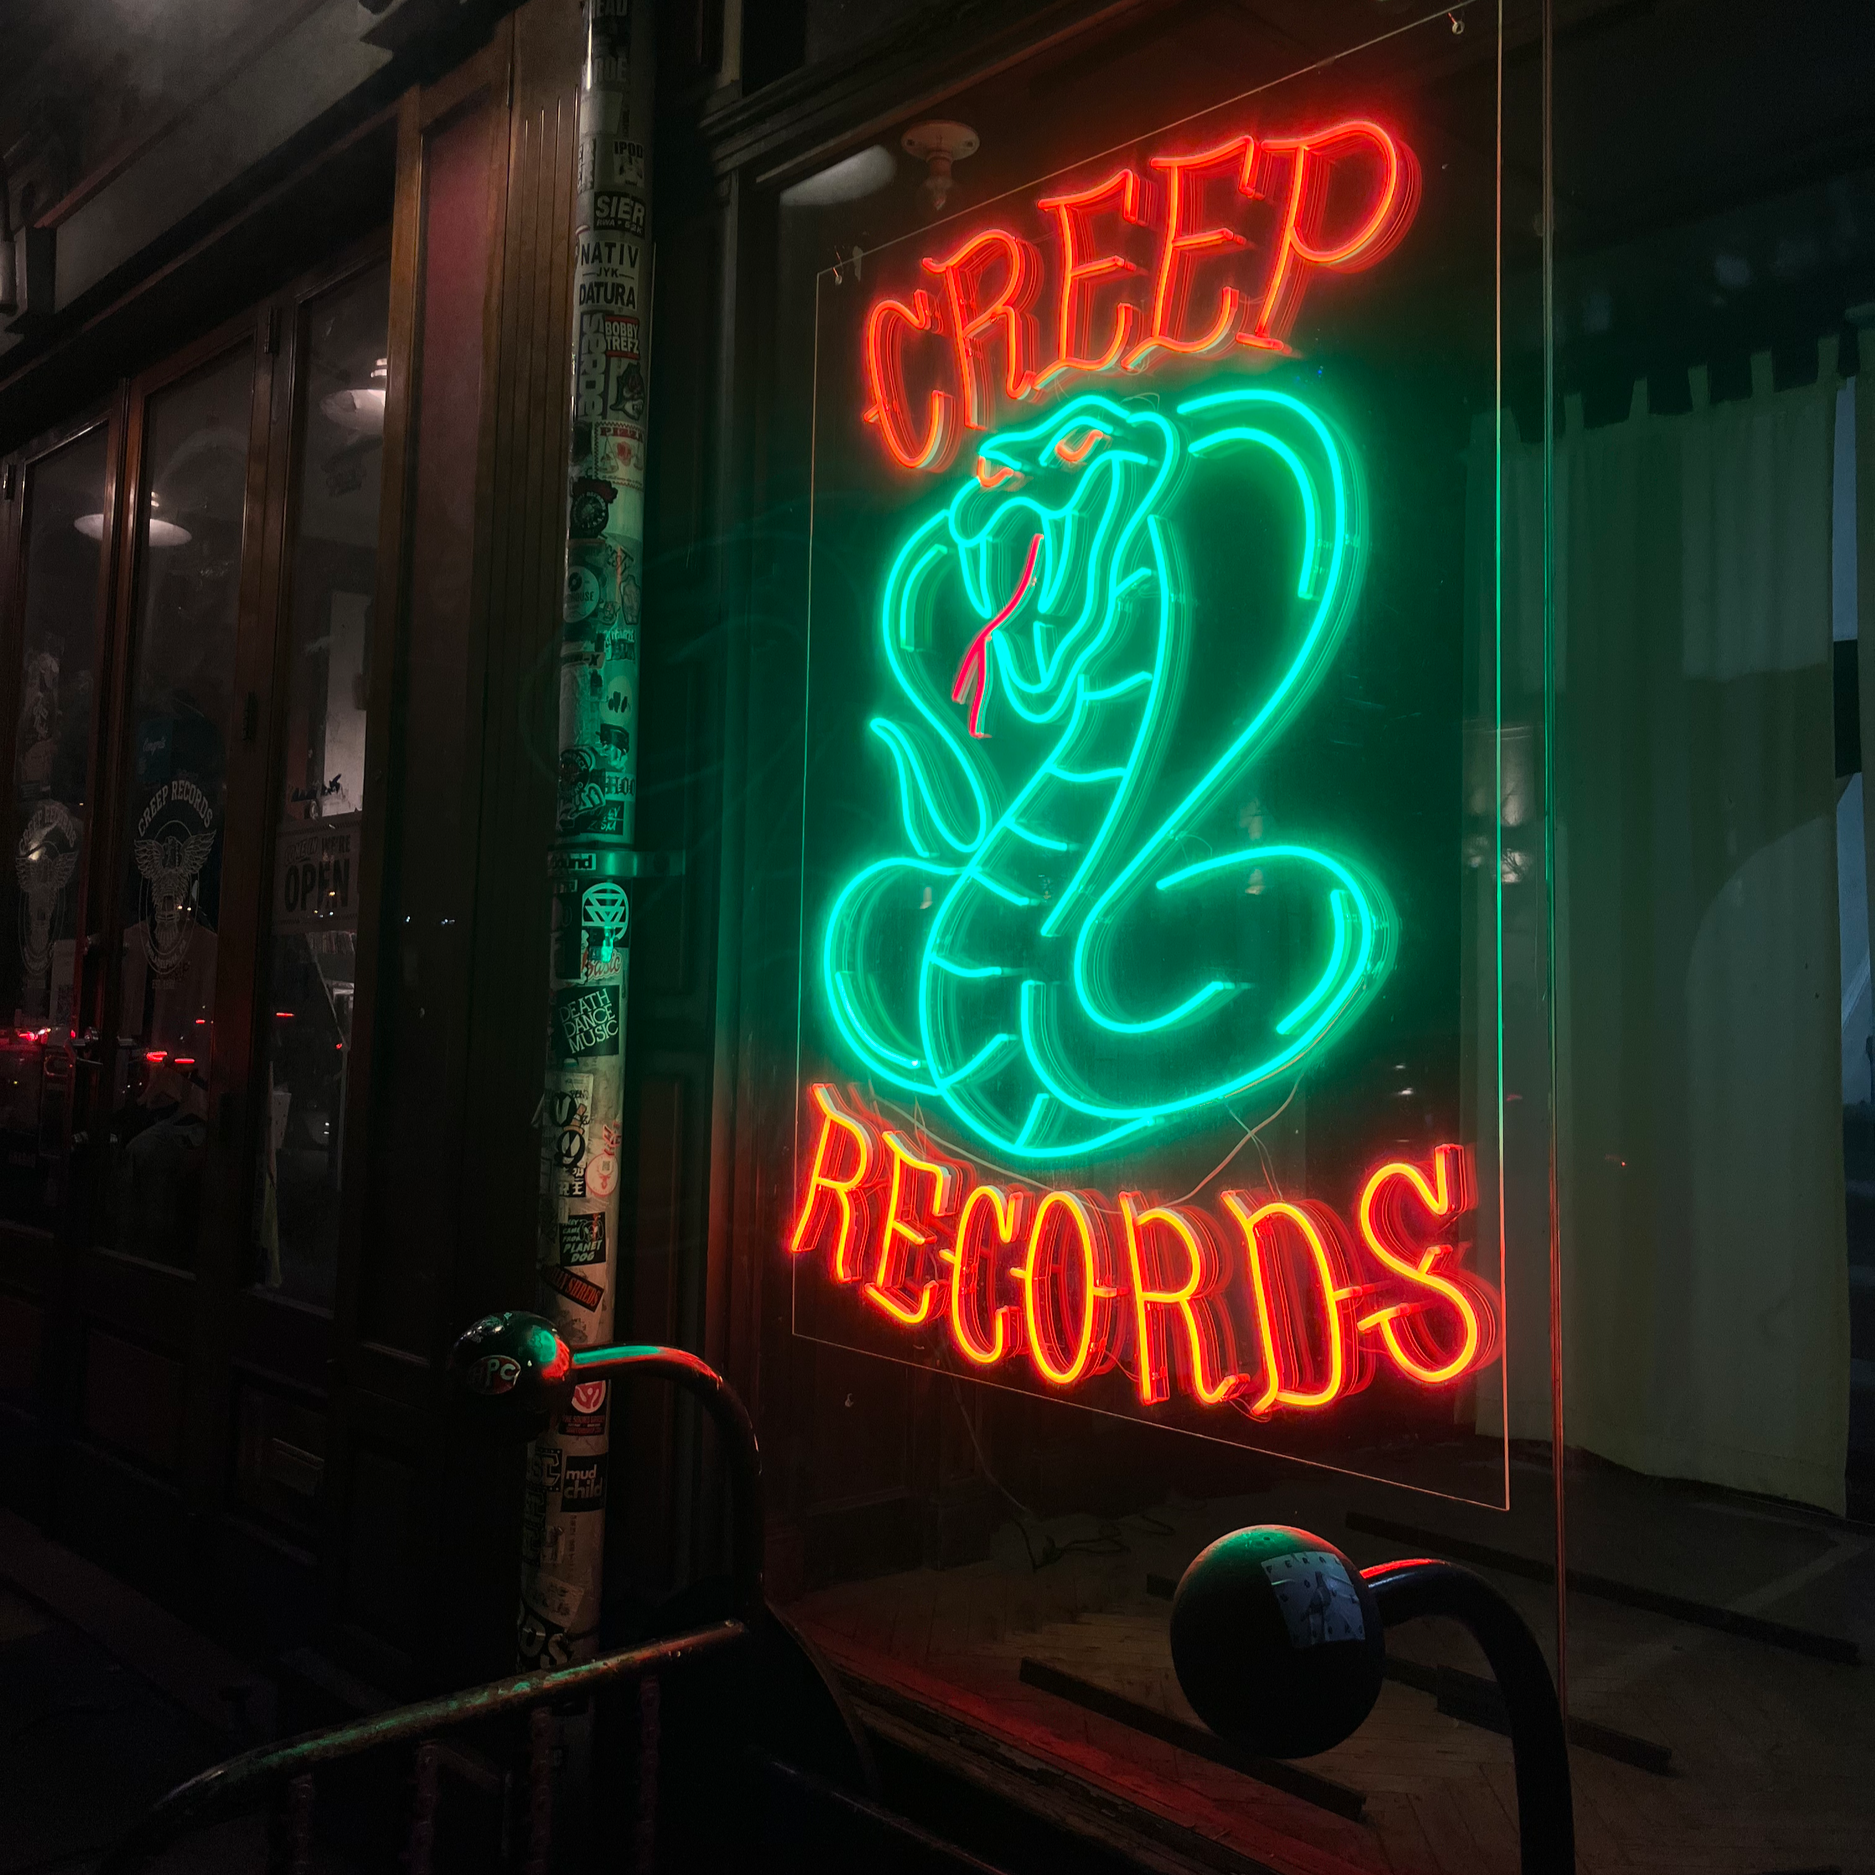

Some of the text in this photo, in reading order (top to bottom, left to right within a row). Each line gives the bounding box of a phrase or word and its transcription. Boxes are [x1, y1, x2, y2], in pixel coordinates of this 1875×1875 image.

[595, 195, 645, 227] SIER
[581, 242, 639, 268] NATIV
[596, 267, 619, 278] JYK
[579, 281, 636, 309] DATURA
[863, 119, 1406, 470] CREEP
[605, 320, 639, 339] BOBBY
[605, 335, 639, 354] TREFZ
[600, 426, 644, 443] PIZZA
[137, 779, 213, 838] CREEP RECORDS
[284, 858, 350, 913] OPEN
[559, 988, 611, 1023] DEATH
[563, 1003, 616, 1038] DANCE
[568, 1020, 619, 1054] MUSIC
[563, 1240, 603, 1254] PLANET
[571, 1251, 595, 1264] DOG
[790, 1083, 1486, 1416] RECORDS
[565, 1277, 601, 1307] SHREDS
[566, 1463, 598, 1480] mud
[563, 1477, 604, 1500] child
